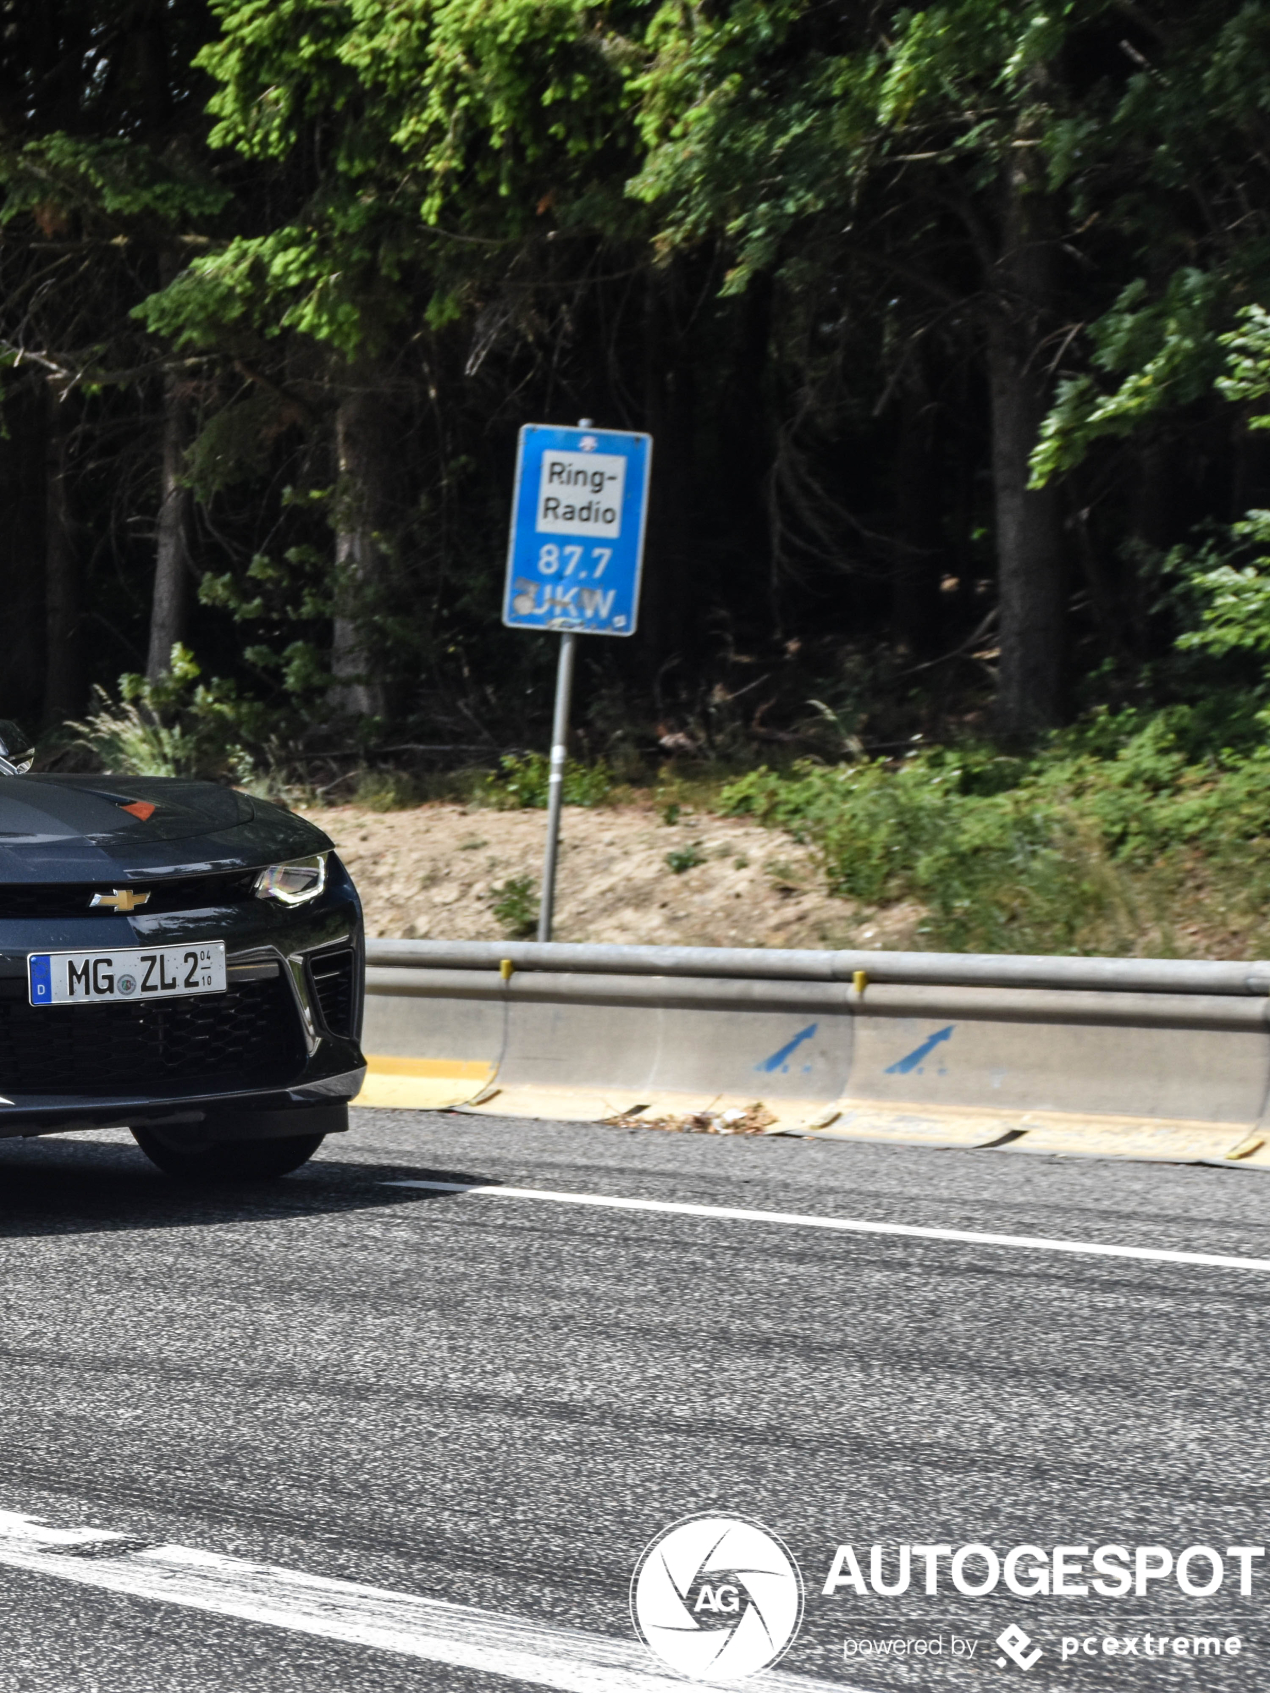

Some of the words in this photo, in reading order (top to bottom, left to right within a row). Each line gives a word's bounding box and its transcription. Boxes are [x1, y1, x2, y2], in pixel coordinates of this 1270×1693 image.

[548, 461, 618, 493] Ring-
[542, 497, 617, 524] Radio
[538, 543, 613, 579] 87.7
[37, 984, 46, 995] D
[67, 958, 114, 996] MG
